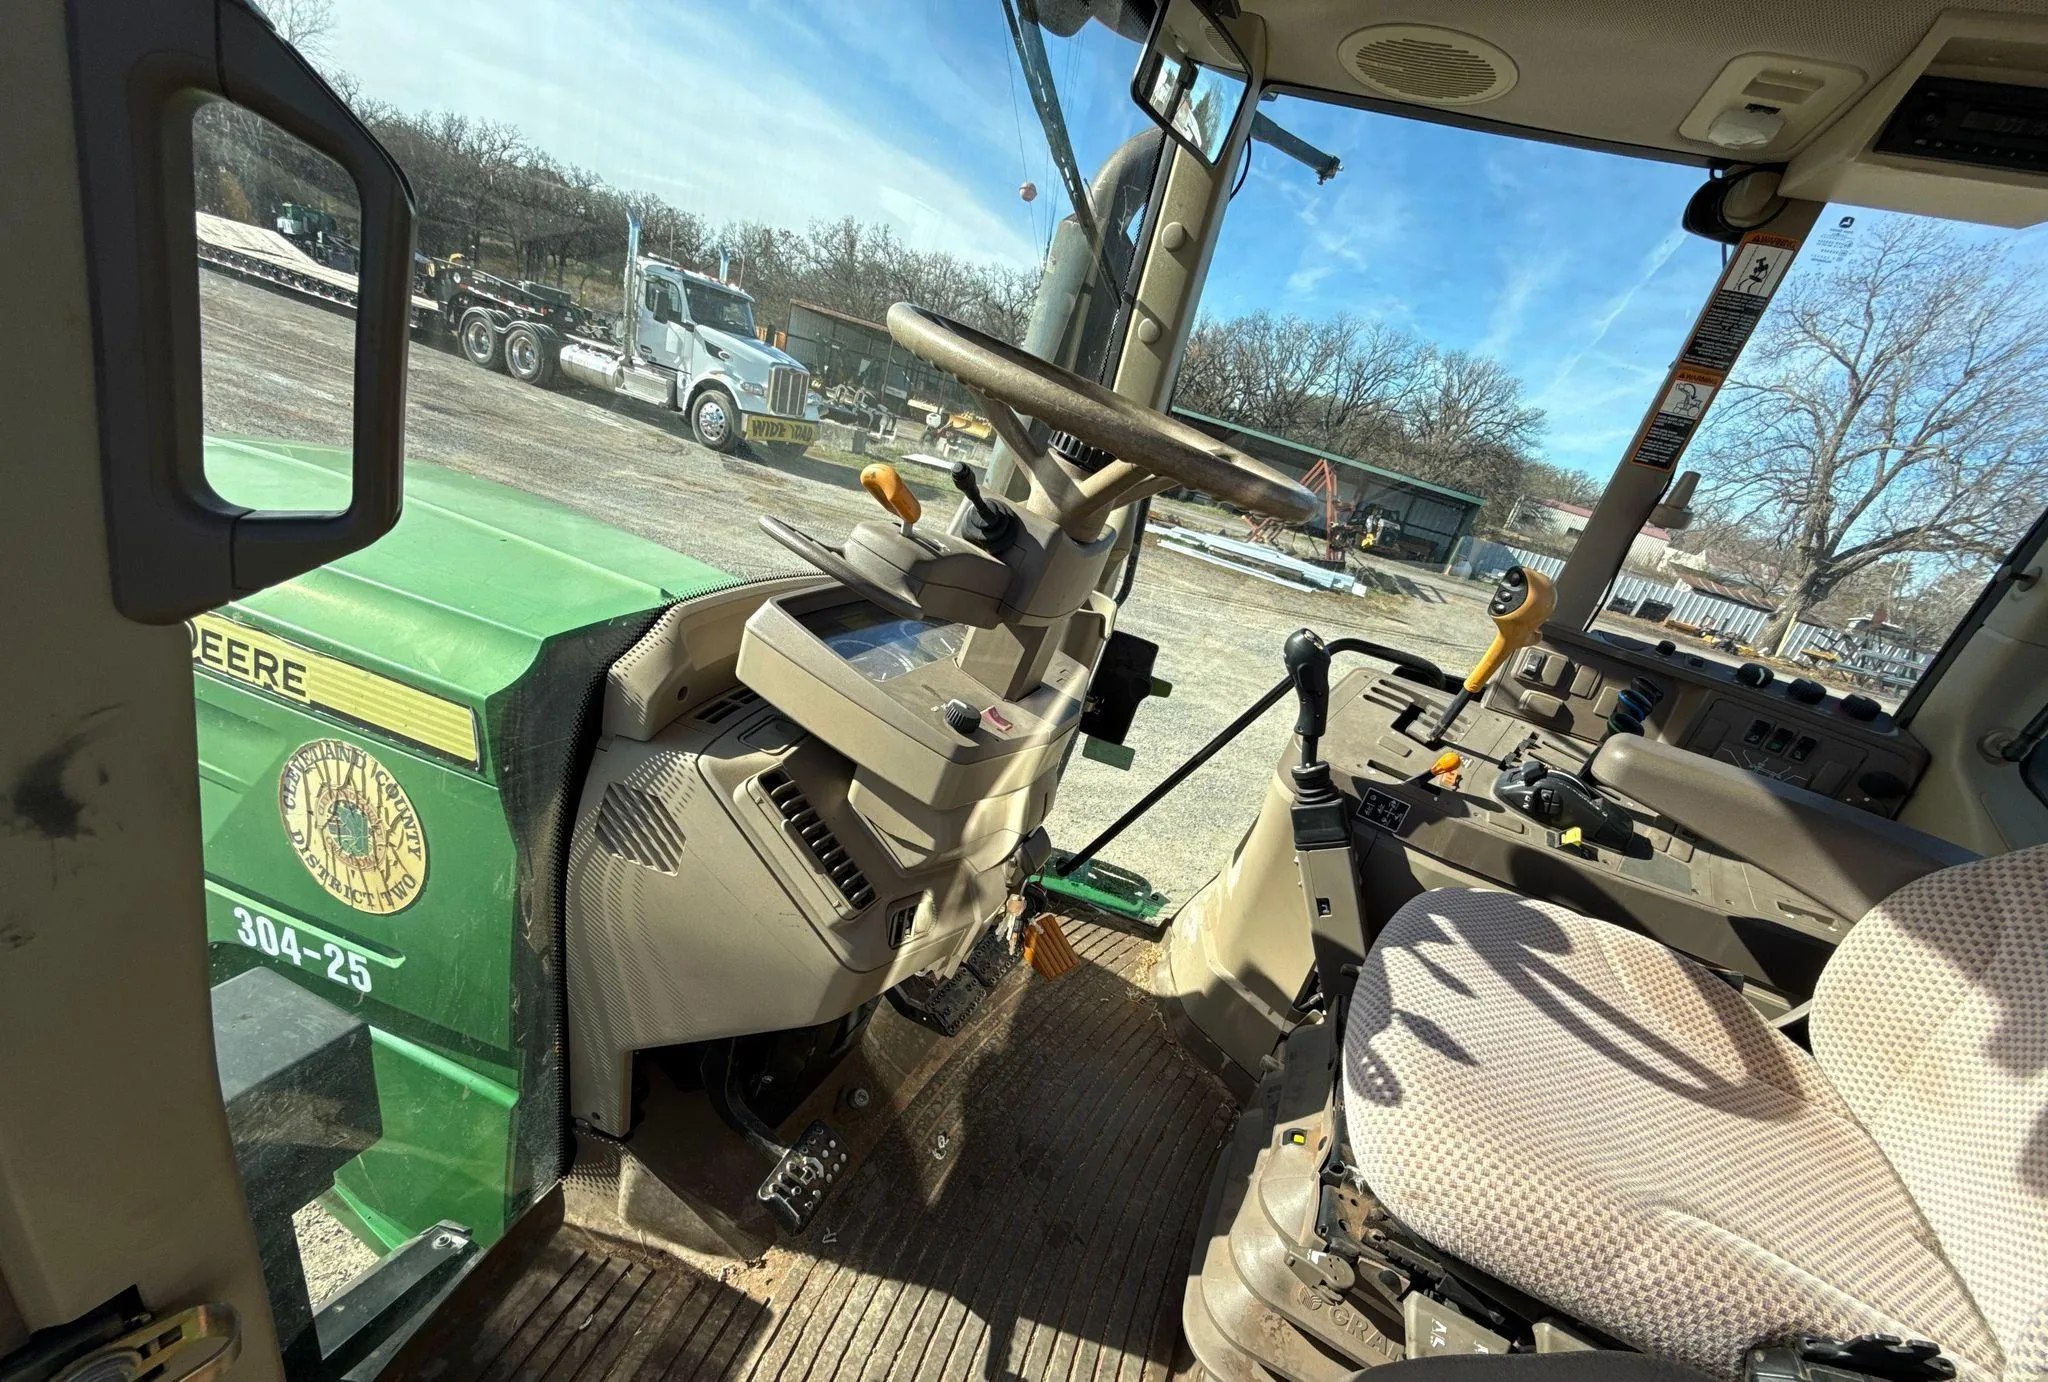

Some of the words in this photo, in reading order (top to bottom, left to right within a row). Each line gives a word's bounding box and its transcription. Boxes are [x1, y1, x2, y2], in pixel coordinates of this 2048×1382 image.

[752, 420, 784, 438] WIDE
[283, 741, 368, 810] CLEVELAND
[374, 770, 422, 862] COUNTY
[291, 828, 375, 907] DISTRICT
[380, 872, 417, 908] TWO
[233, 906, 372, 993] 304-25
